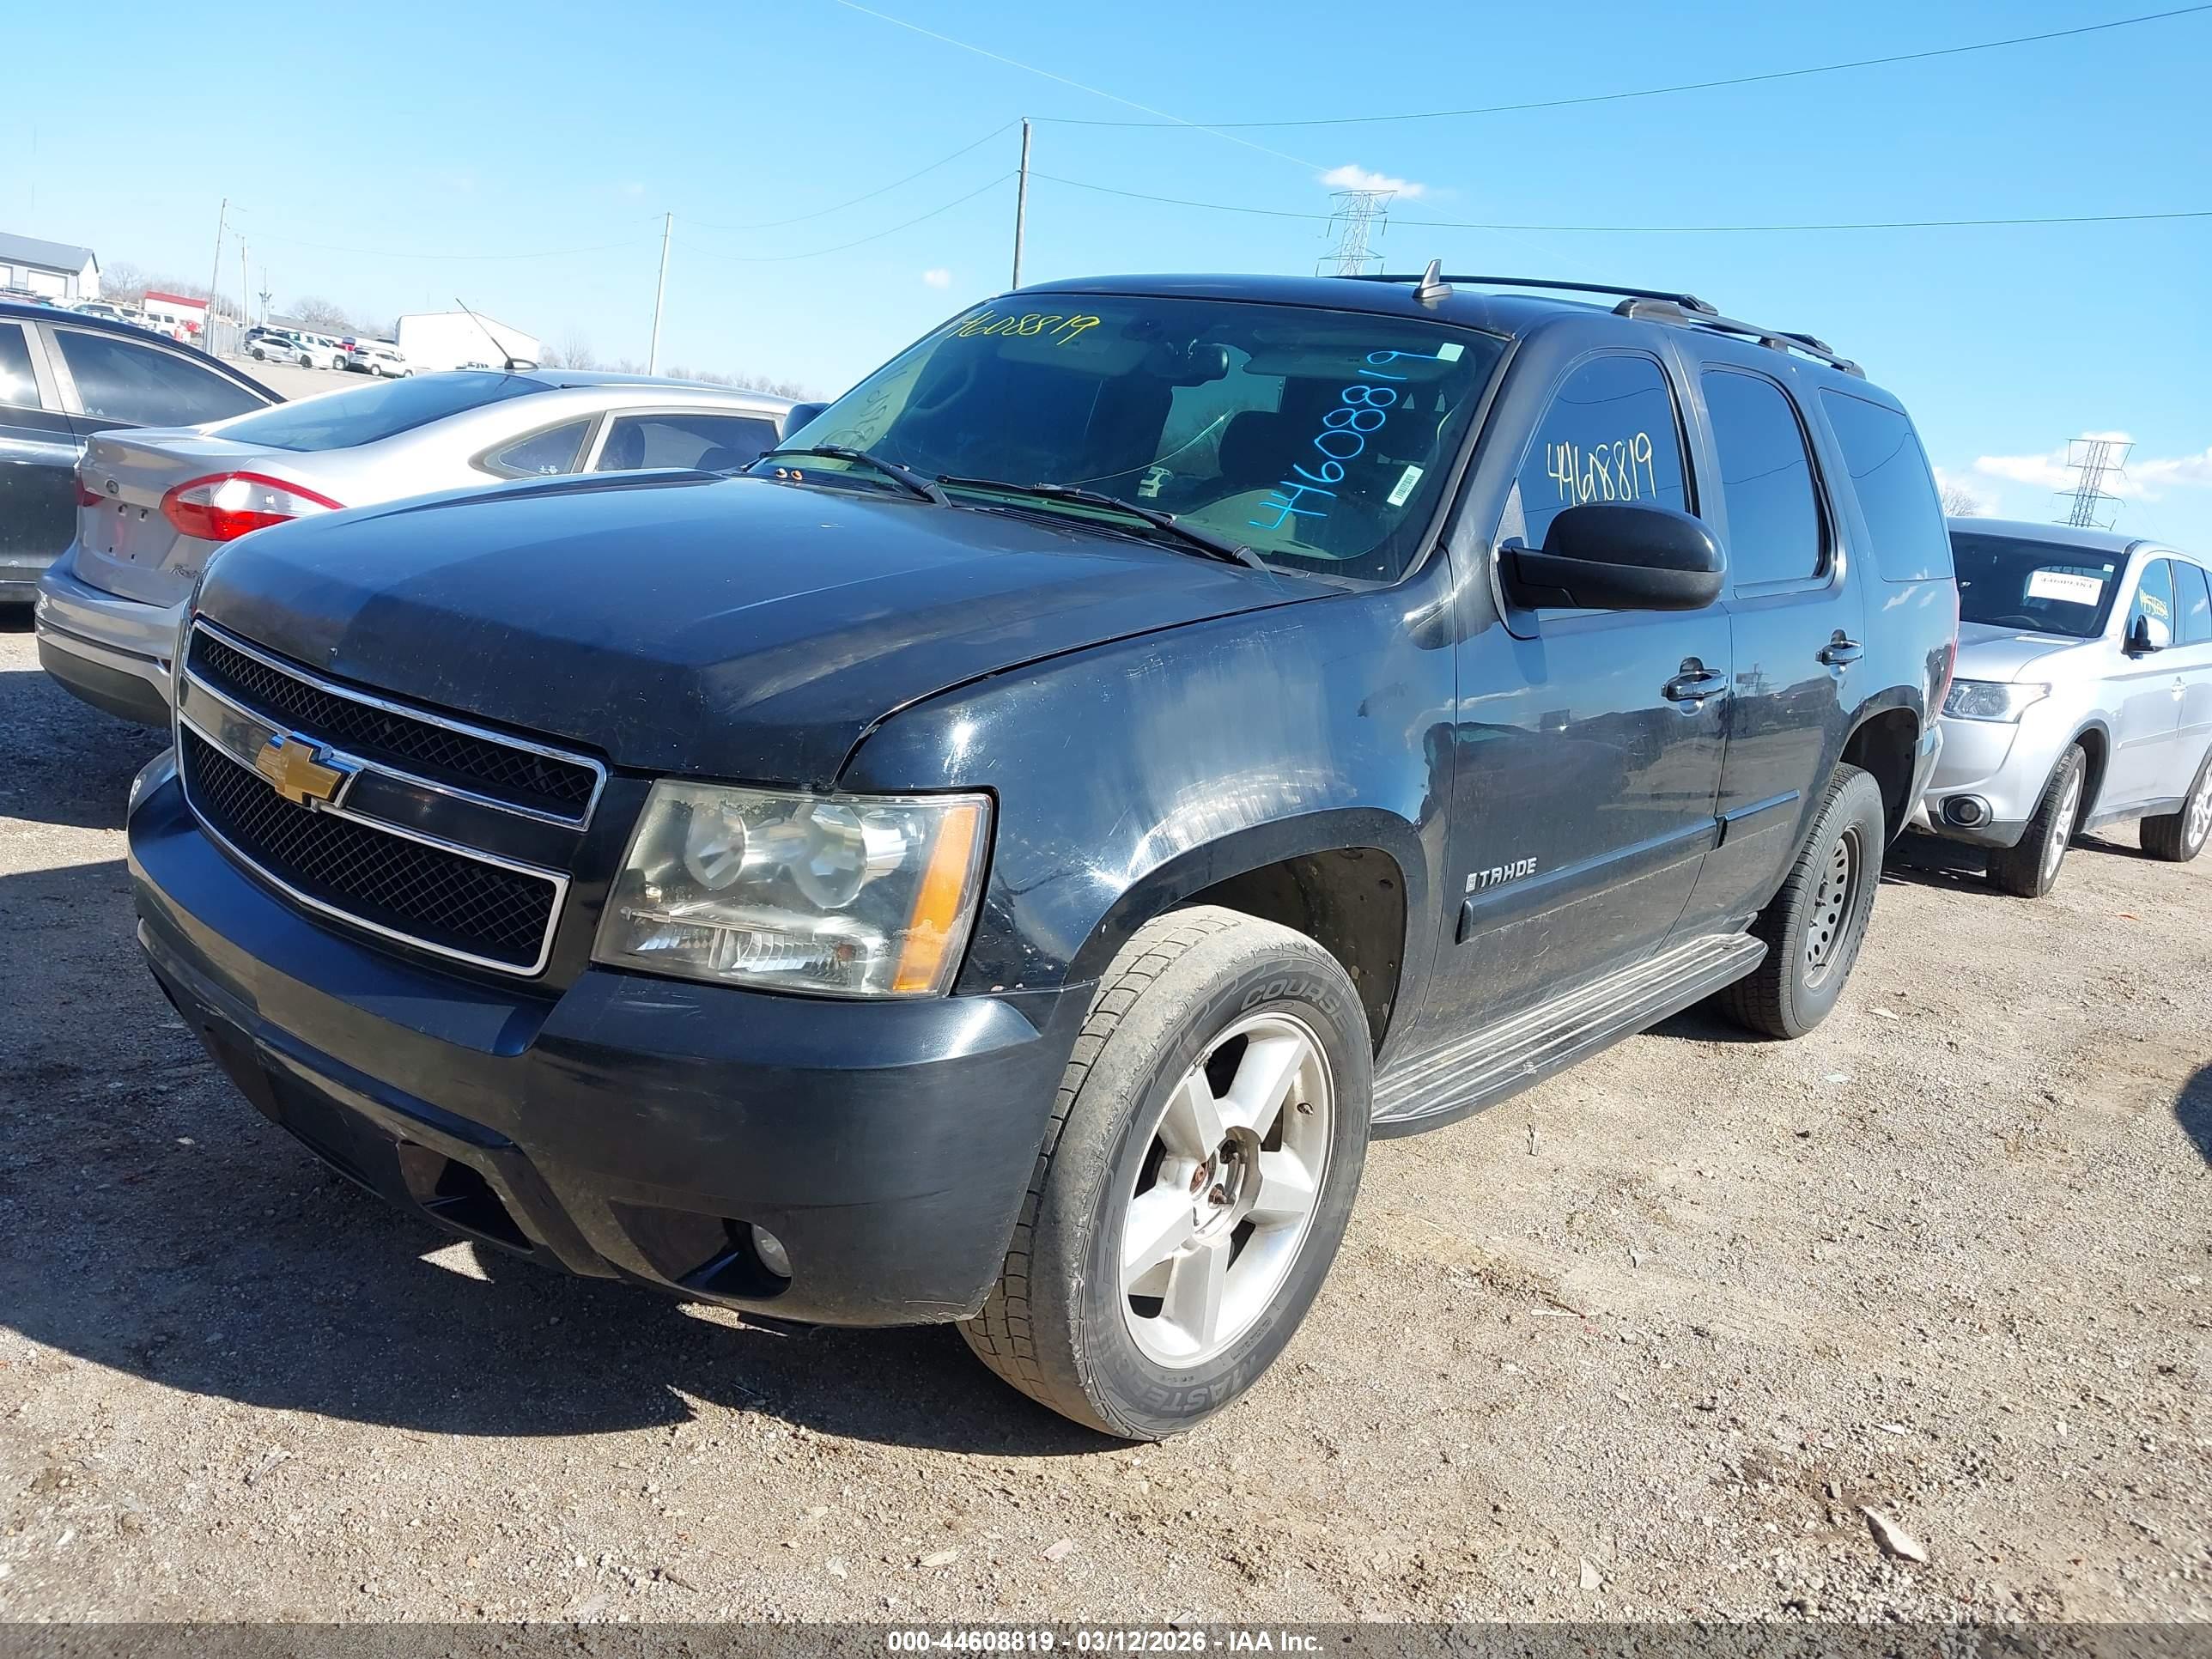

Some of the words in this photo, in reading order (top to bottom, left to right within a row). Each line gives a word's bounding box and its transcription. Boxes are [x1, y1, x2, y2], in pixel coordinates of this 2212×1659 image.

[1248, 350, 1439, 529] 44608819
[1547, 432, 1656, 506] 44608819
[1480, 857, 1537, 888] TAHOE
